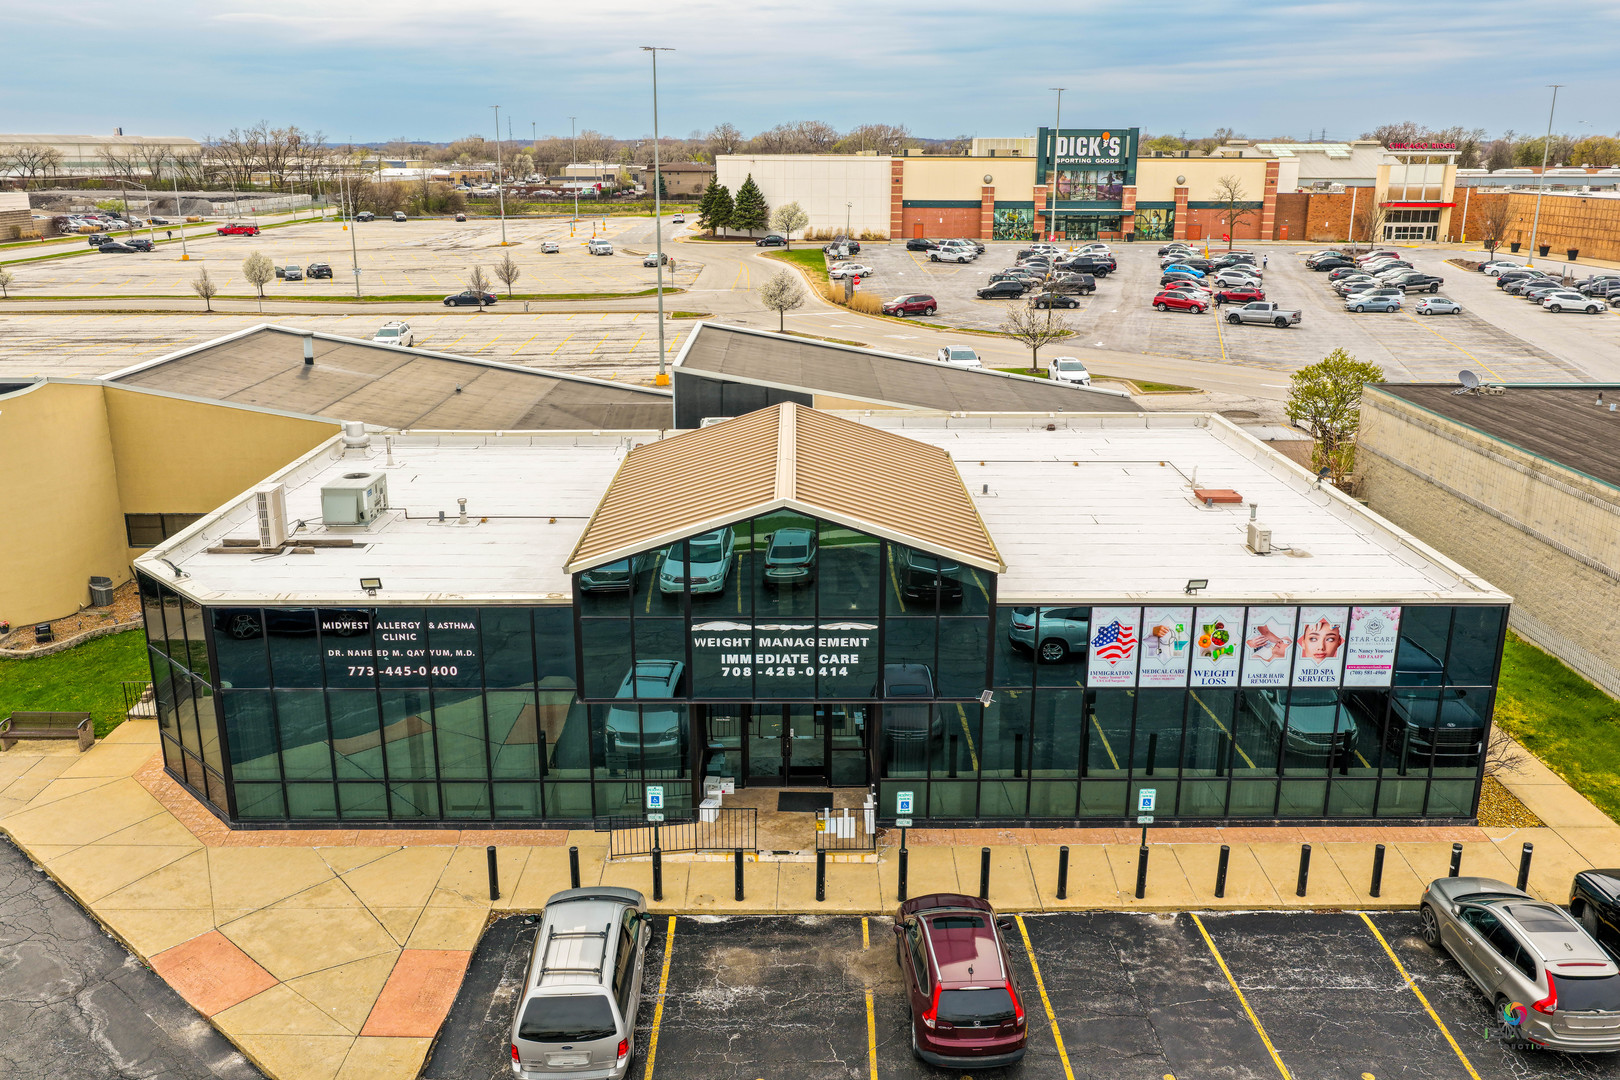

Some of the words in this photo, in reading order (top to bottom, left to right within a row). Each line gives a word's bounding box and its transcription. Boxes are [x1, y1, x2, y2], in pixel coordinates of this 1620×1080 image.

[1057, 136, 1120, 156] DICK'S
[322, 622, 369, 630] MIDWEST
[376, 622, 420, 630] ALLERGY
[382, 633, 417, 641] CLINIC
[694, 638, 752, 647] WEIGHT
[759, 638, 870, 647] MANAGEMENT
[721, 654, 808, 664] IMMEDIATE
[819, 654, 858, 664] CARE
